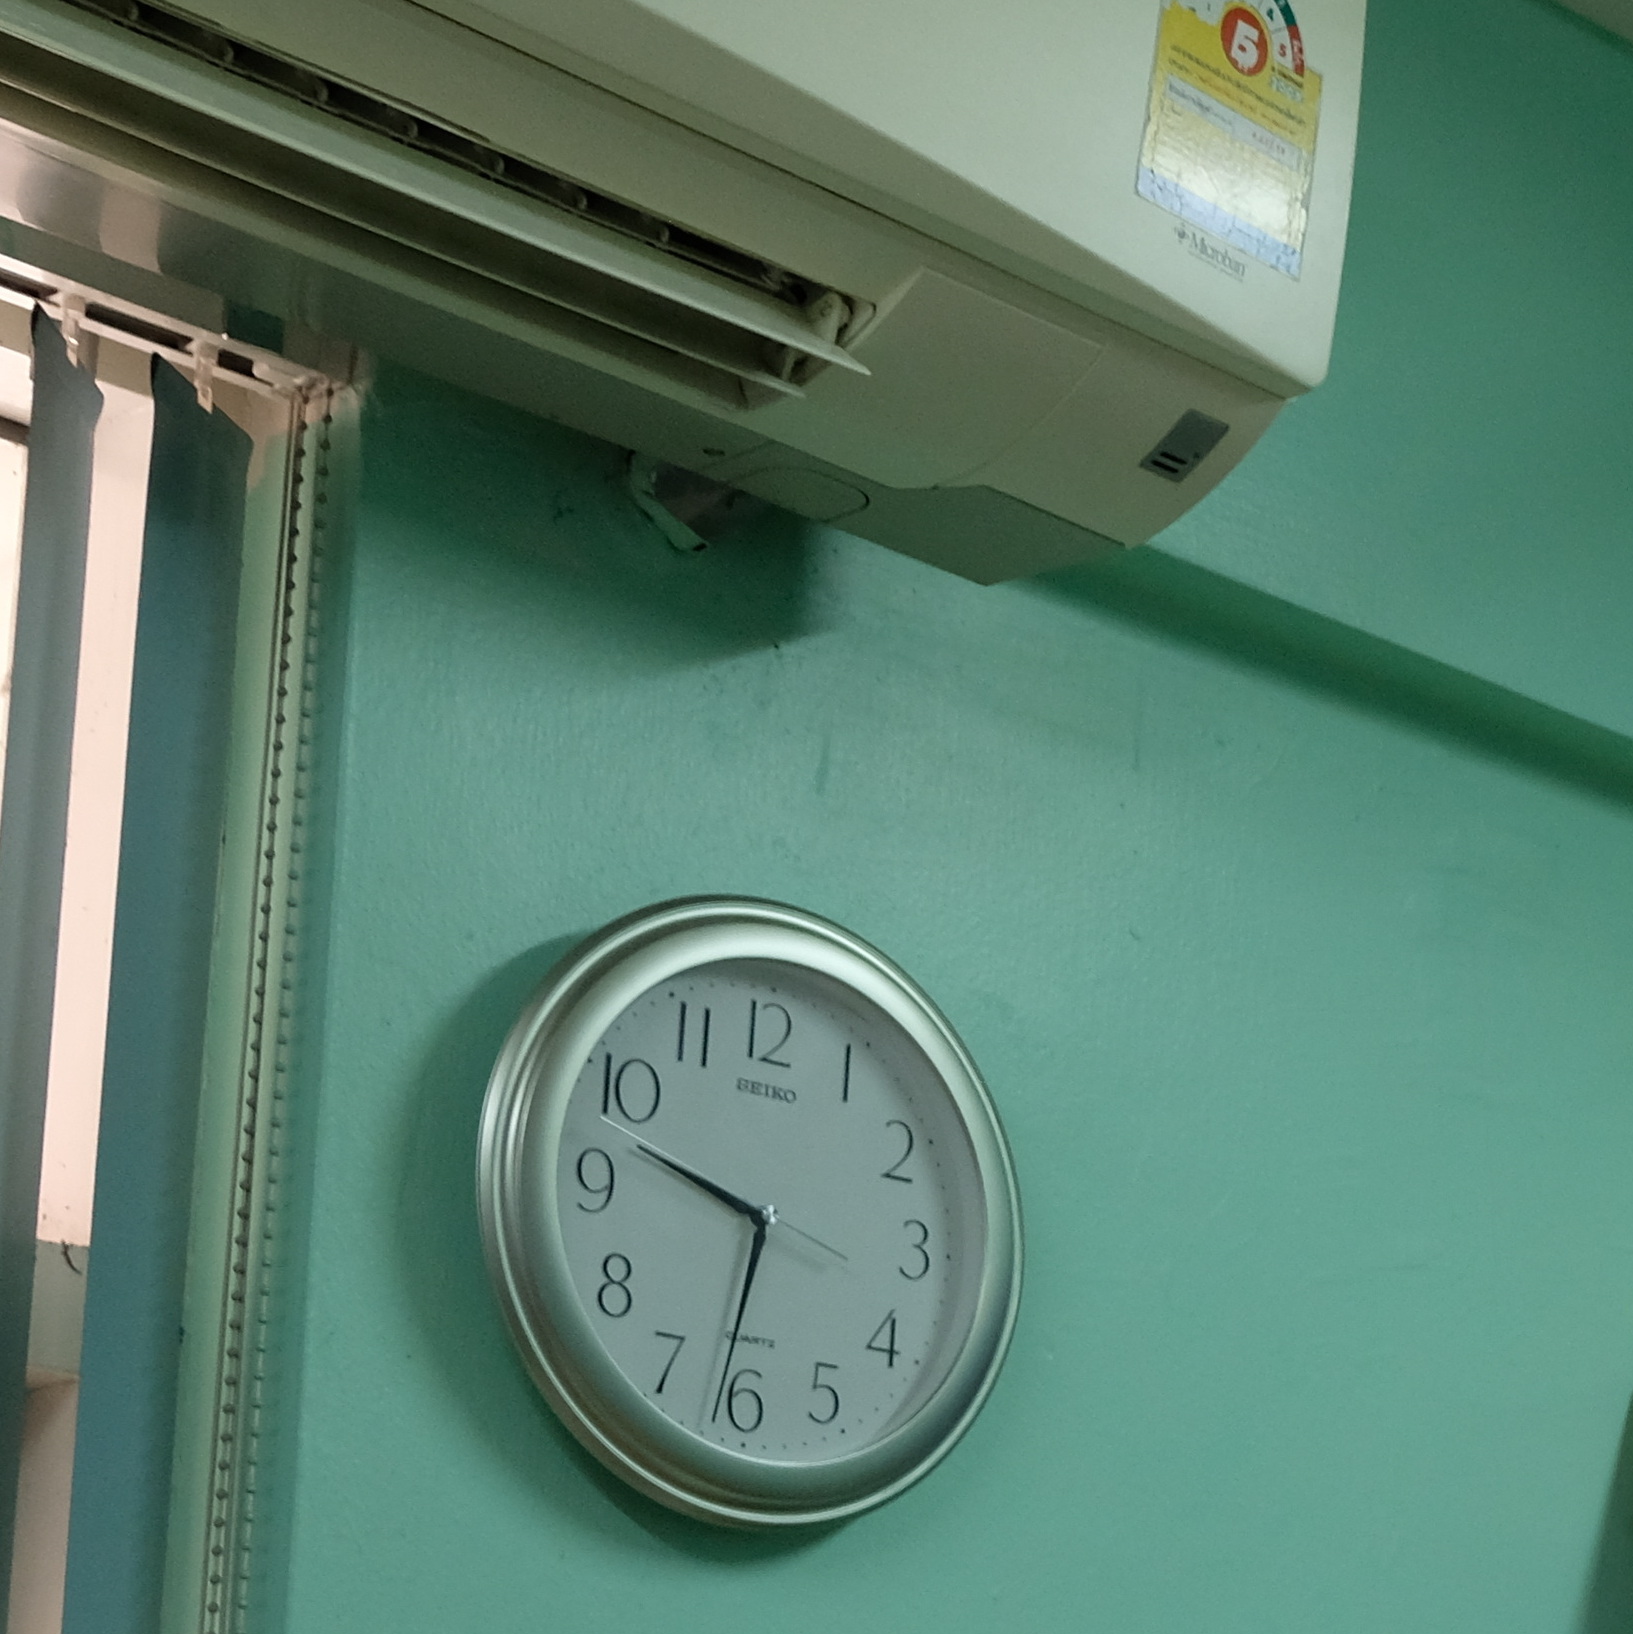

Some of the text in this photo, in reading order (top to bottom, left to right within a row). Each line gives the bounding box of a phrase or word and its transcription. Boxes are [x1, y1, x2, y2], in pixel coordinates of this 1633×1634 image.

[677, 1001, 711, 1068] 11
[747, 999, 793, 1069] 12
[602, 1053, 662, 1123] 10
[736, 1077, 797, 1104] SEIKO
[842, 1043, 852, 1103] 1
[574, 1148, 615, 1212] 9
[881, 1120, 914, 1184] 2
[899, 1219, 931, 1281] 3
[596, 1252, 633, 1319] 8
[654, 1330, 686, 1395] 7
[865, 1309, 901, 1368] 4
[726, 1369, 765, 1433] 6
[808, 1362, 840, 1425] 5
